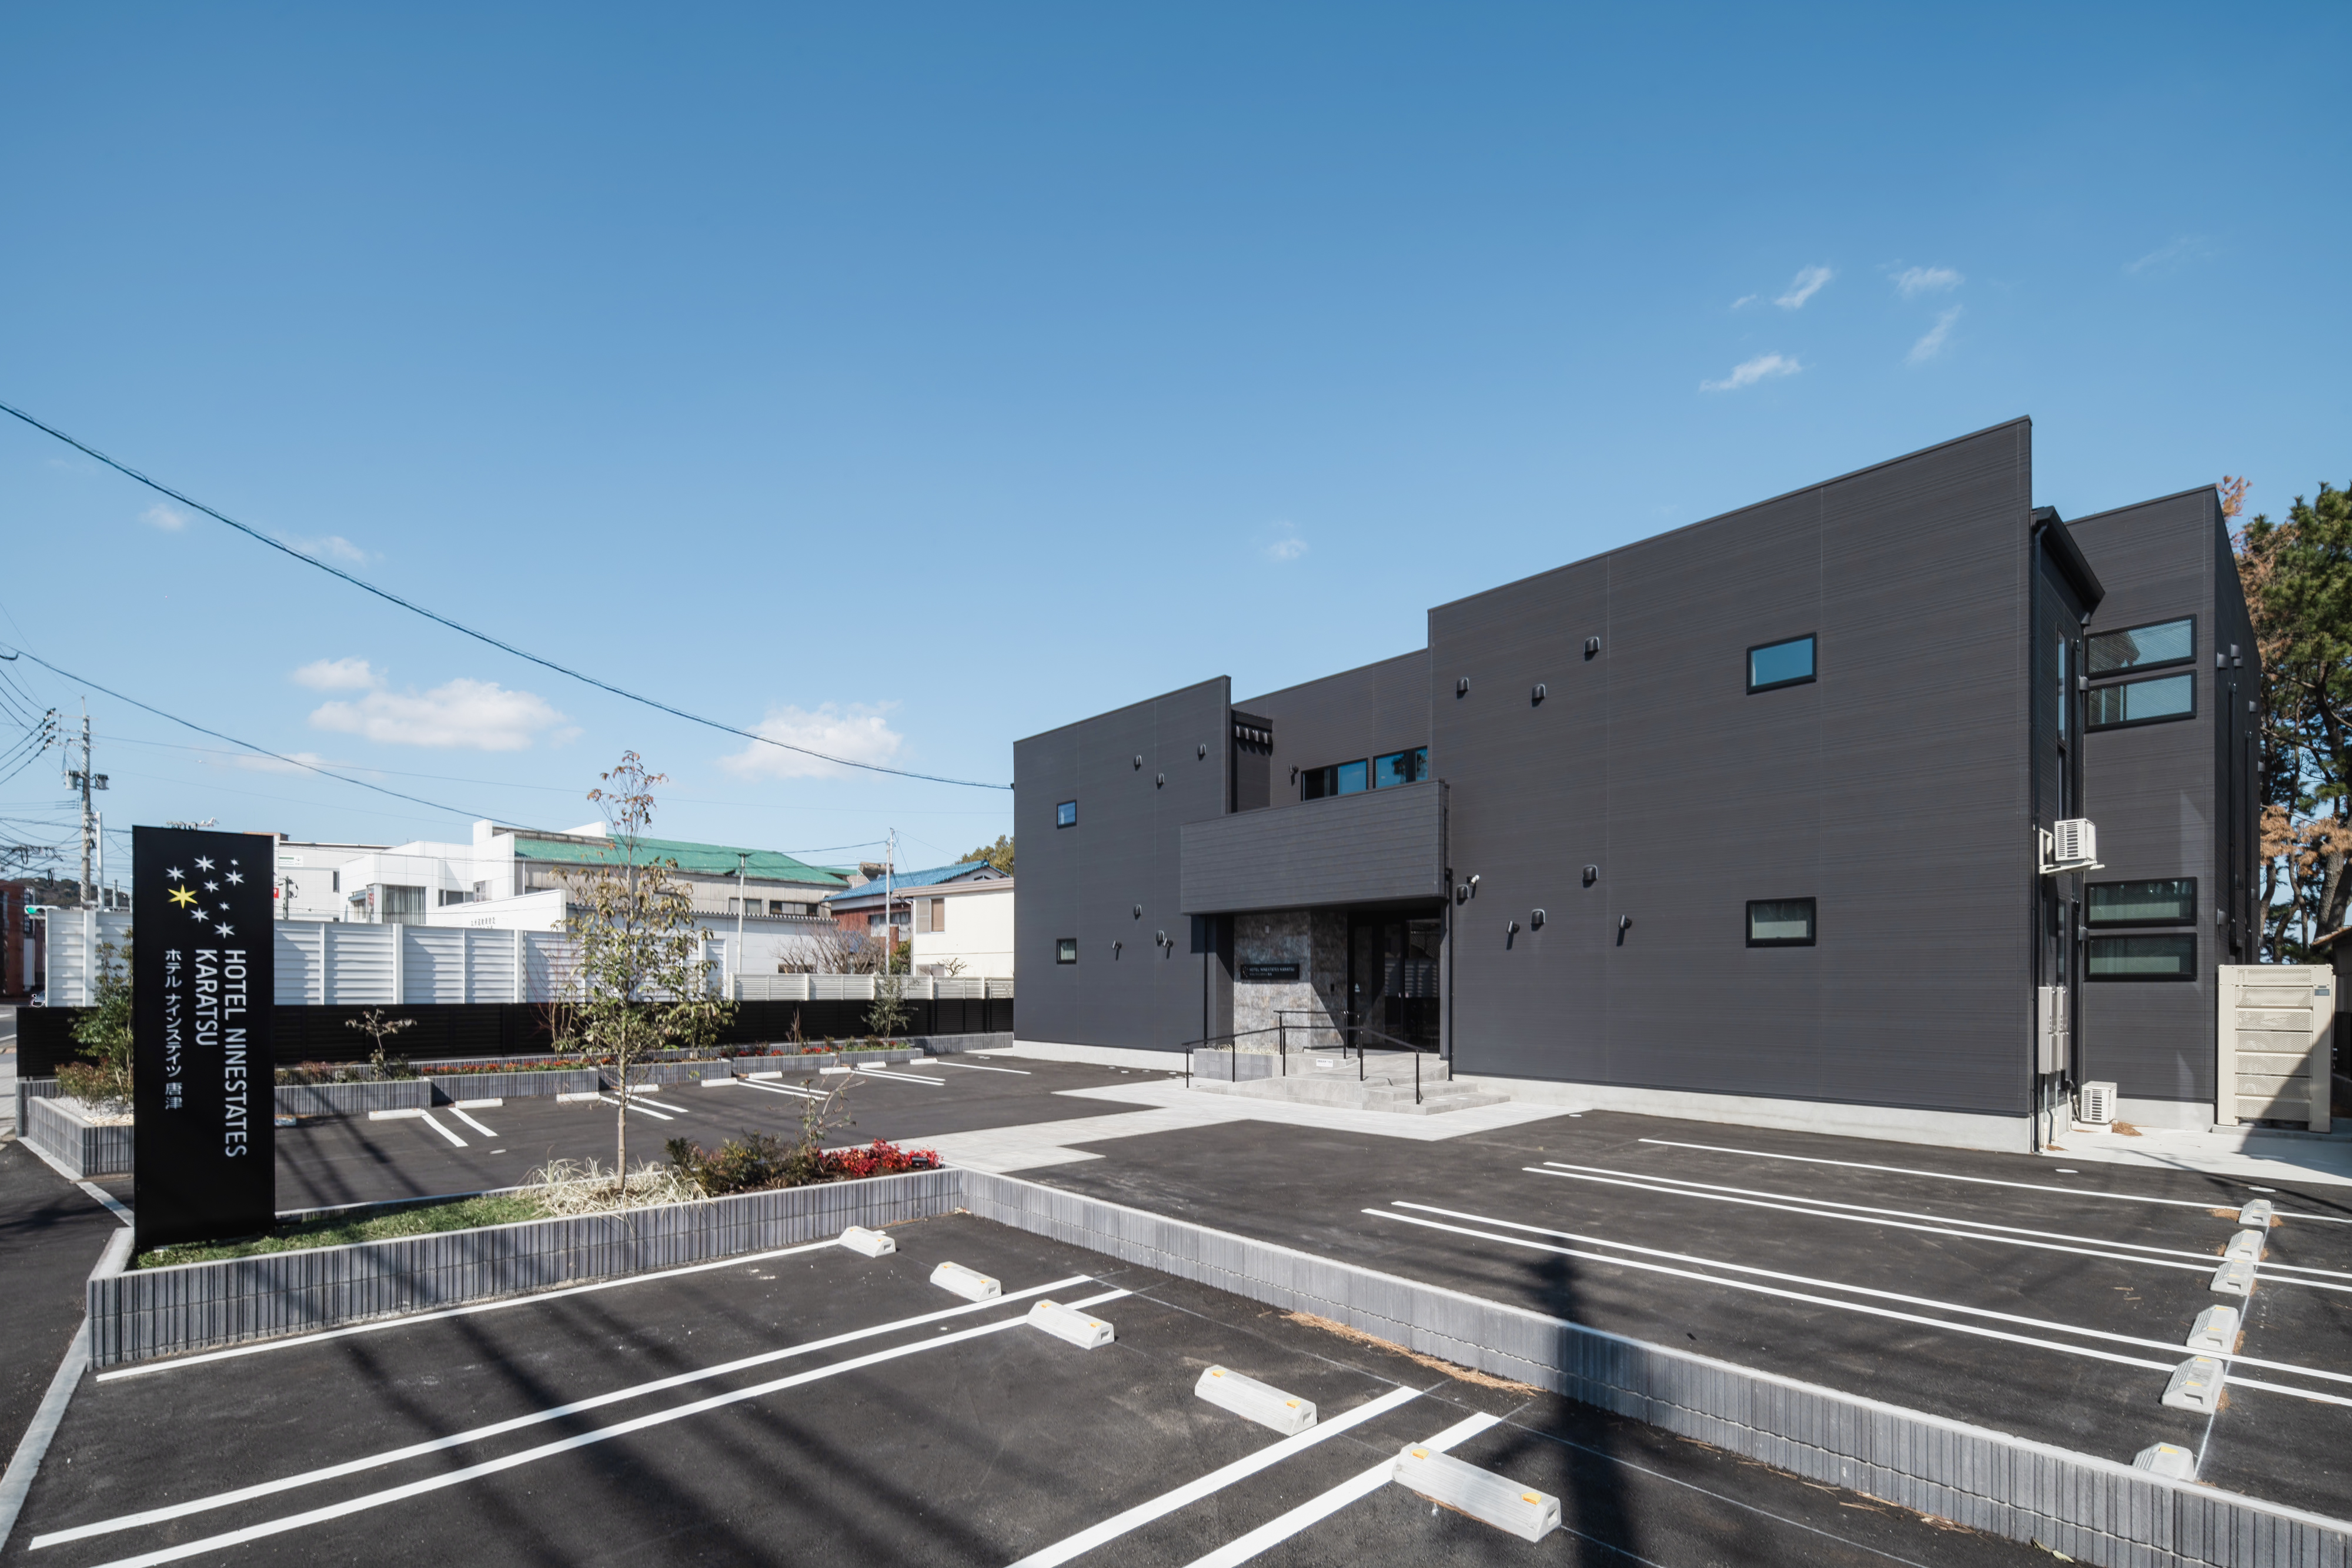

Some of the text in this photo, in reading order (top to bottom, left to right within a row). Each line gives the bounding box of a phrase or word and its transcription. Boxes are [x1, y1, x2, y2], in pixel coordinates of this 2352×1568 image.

[165, 949, 183, 1110] ホテル ナインステイツ 唐津
[195, 949, 218, 1045] KARATSU
[225, 950, 247, 1157] HOTEL NINESTATES
